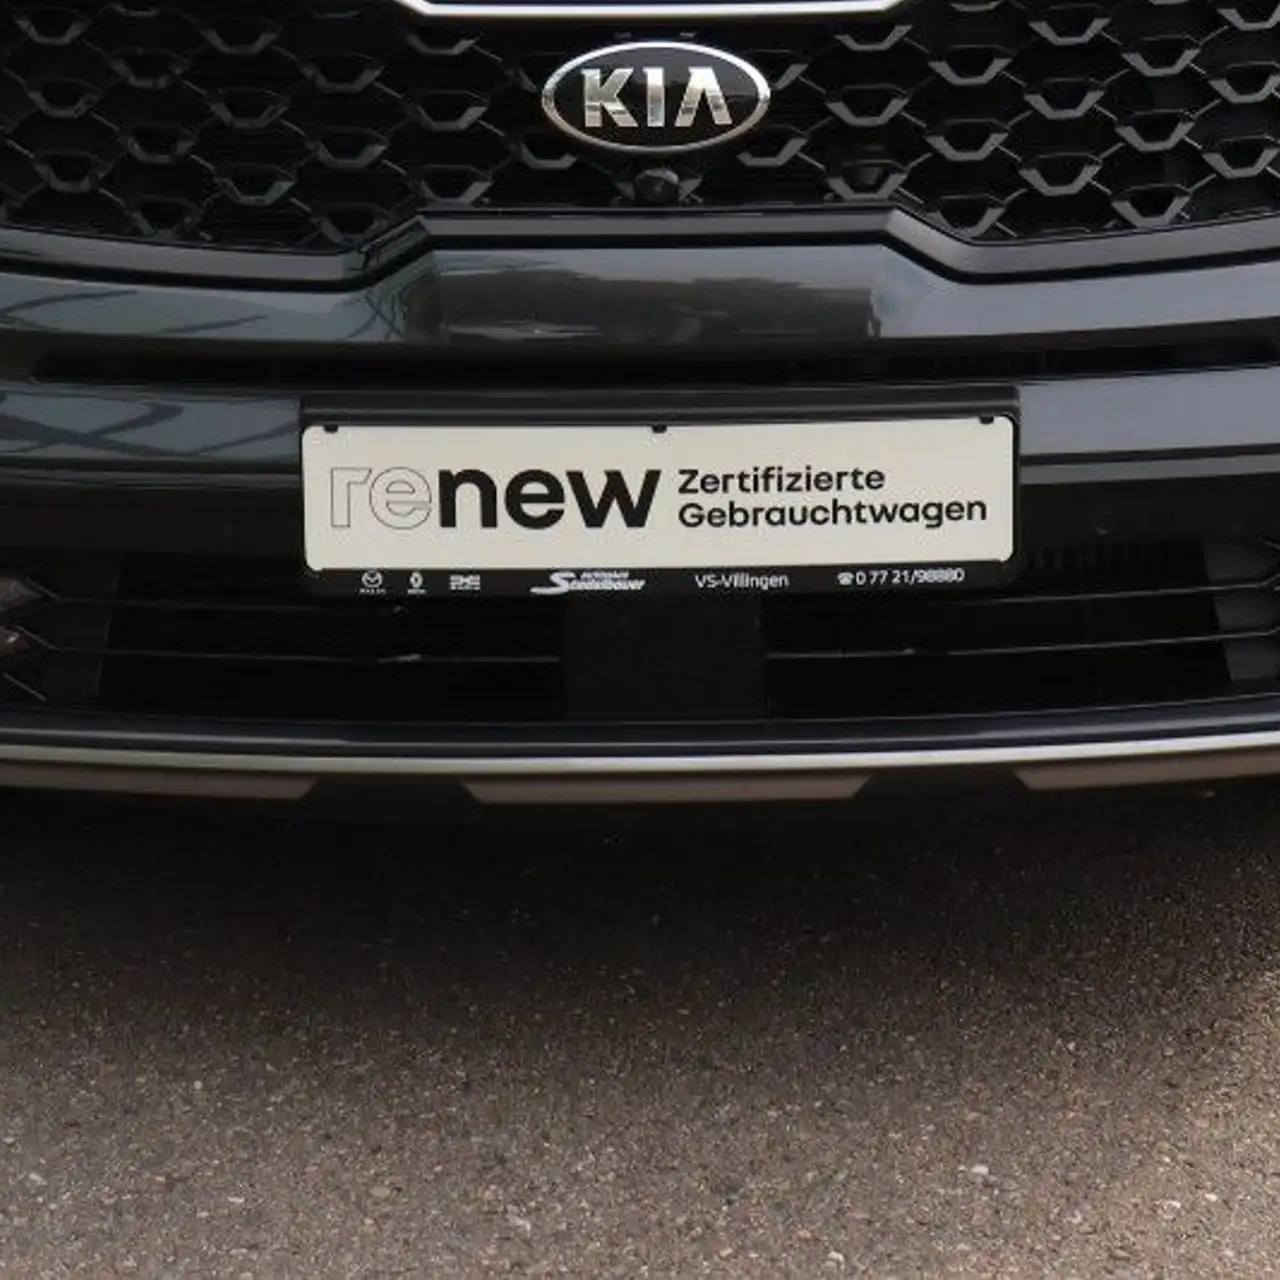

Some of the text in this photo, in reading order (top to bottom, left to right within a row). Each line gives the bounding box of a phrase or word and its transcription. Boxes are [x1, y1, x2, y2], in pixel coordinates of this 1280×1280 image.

[581, 66, 733, 128] KIA
[677, 465, 886, 495] Zertifizierte
[330, 466, 662, 530] renew
[677, 498, 987, 528] Gebrauchtwagen
[694, 573, 790, 591] VS-Villingen
[855, 571, 867, 586] 0
[869, 570, 887, 585] 77
